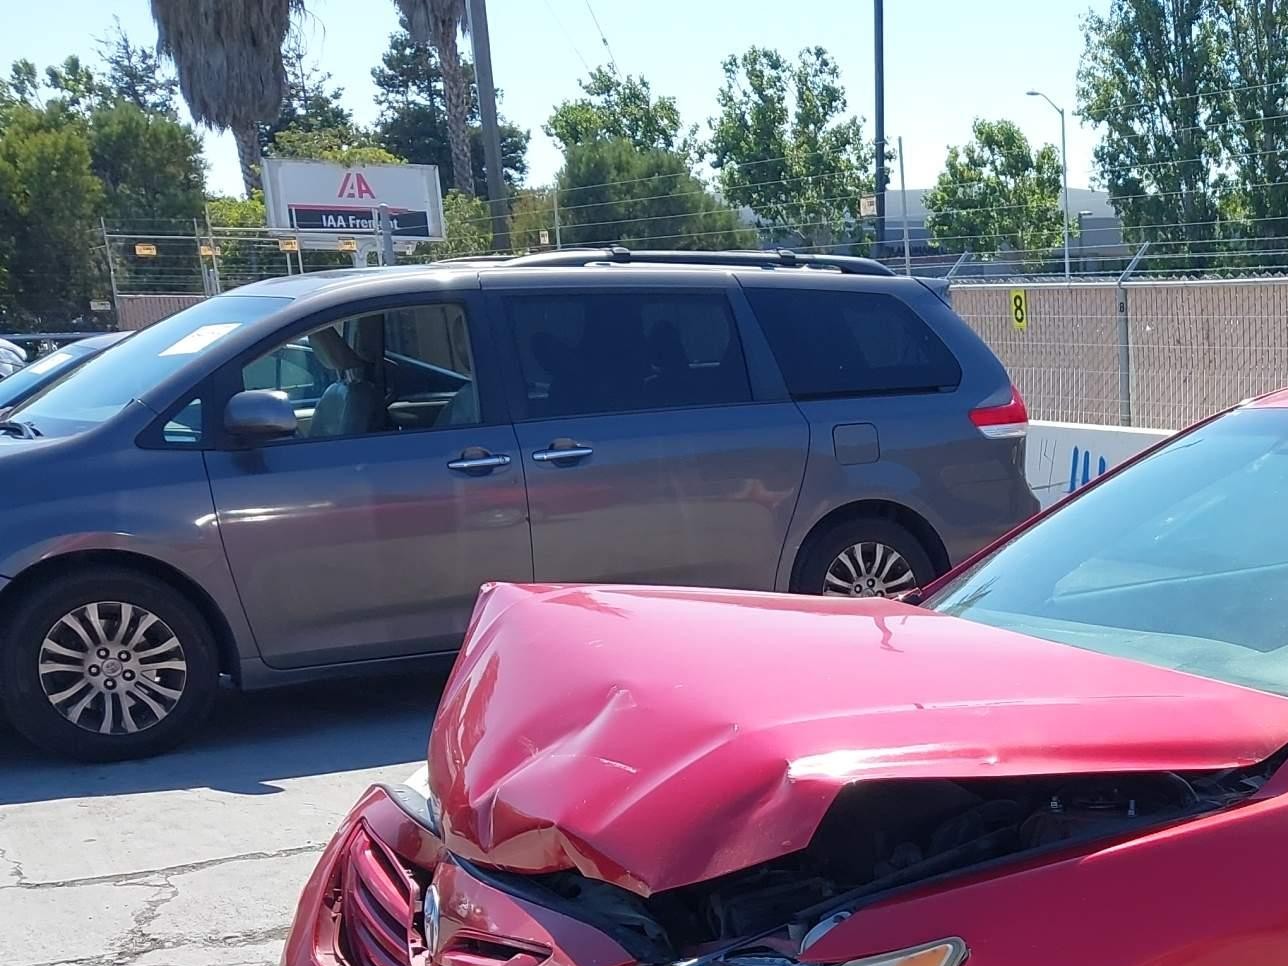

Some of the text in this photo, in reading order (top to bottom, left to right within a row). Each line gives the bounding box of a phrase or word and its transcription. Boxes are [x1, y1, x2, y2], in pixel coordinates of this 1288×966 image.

[322, 214, 399, 230] IAA Fremnt
[1013, 294, 1025, 323] 8
